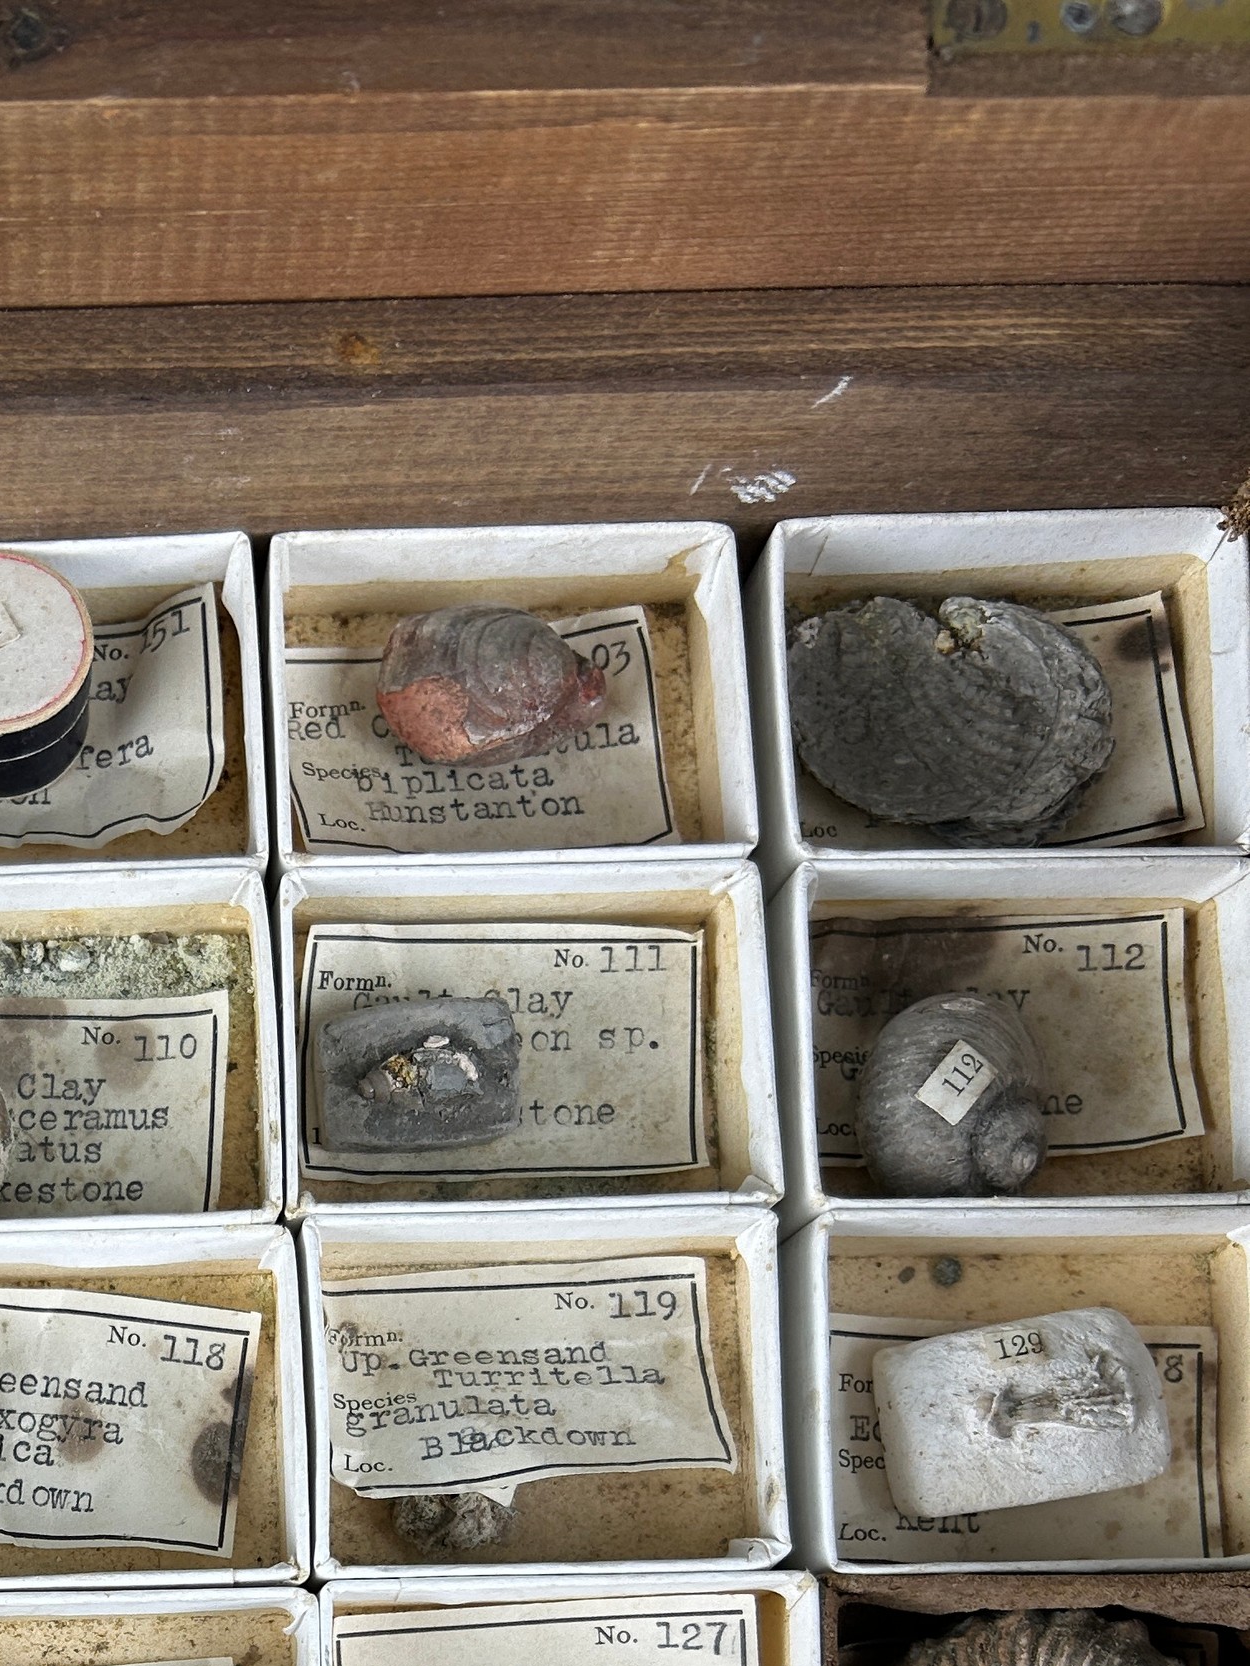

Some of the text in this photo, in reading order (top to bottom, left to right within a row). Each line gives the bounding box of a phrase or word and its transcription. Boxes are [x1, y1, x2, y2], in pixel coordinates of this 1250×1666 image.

[93, 645, 129, 662] No.
[320, 814, 366, 832] Loc.
[367, 795, 585, 826] Hunstanton
[553, 945, 668, 973] No. 111
[1022, 934, 1146, 972] No. 112
[81, 1026, 198, 1063] No. 110
[598, 1026, 660, 1052] sp.
[17, 1073, 106, 1107] Clay
[942, 1053, 984, 1097] 112
[554, 1290, 677, 1321] No. 119
[108, 1325, 225, 1371] No. 118
[994, 1332, 1043, 1361] 129
[434, 1365, 666, 1388] Turritella
[333, 1390, 417, 1412] Species
[346, 1396, 556, 1437] granulata
[344, 1454, 393, 1472] Loc.
[837, 1523, 887, 1541] Loc.
[595, 1621, 727, 1655] No. 127
